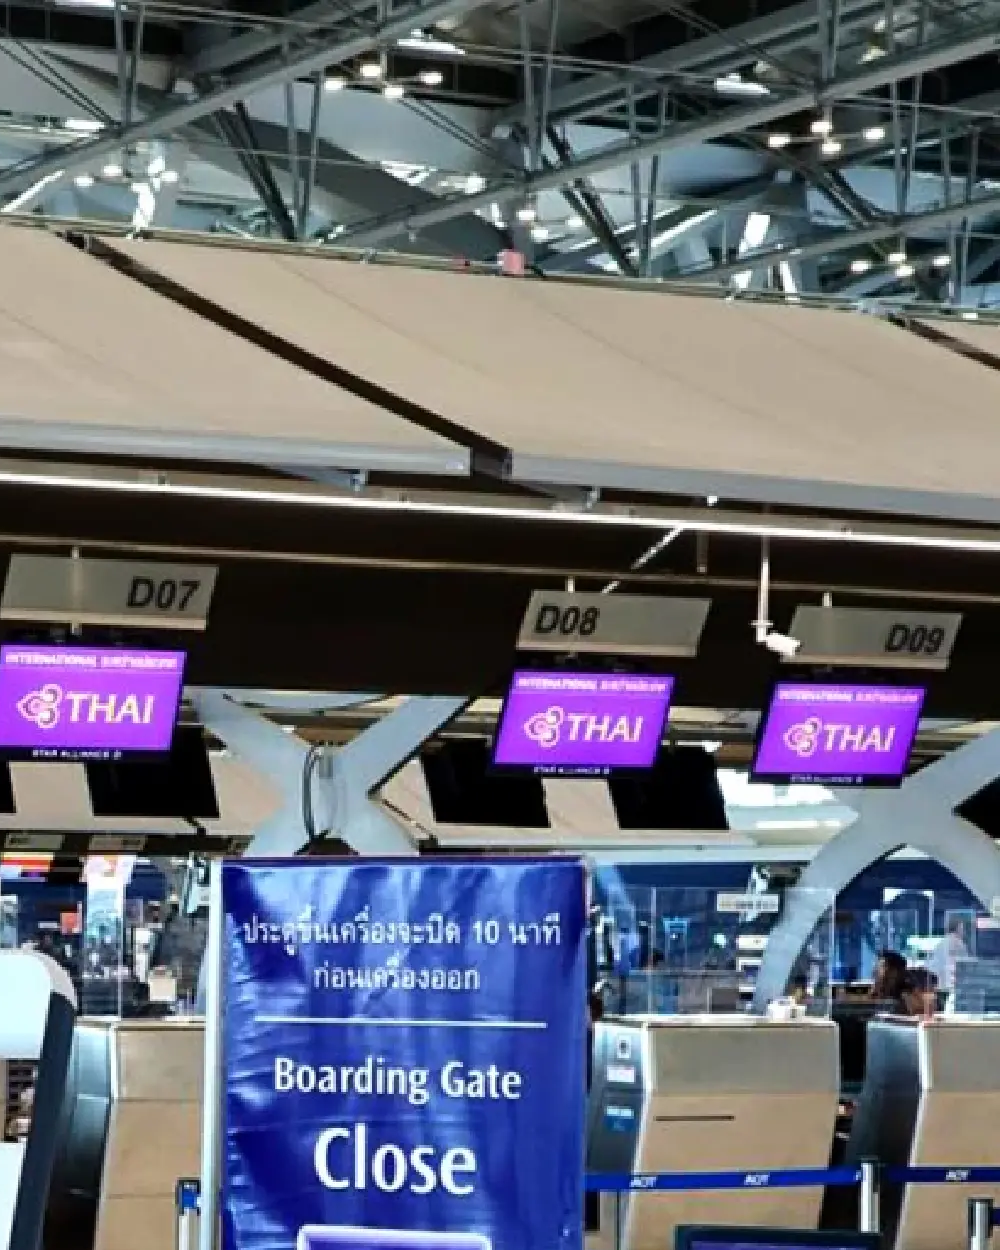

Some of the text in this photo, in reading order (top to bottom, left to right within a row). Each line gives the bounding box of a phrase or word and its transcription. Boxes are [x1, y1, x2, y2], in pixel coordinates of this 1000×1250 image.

[126, 576, 199, 611] D07
[534, 604, 599, 636] D08
[884, 624, 945, 654] D09
[5, 652, 97, 669] INTERNATIONAL
[65, 691, 155, 725] THAI
[566, 712, 645, 743] THAI
[823, 724, 896, 753] THAI
[243, 904, 561, 956] ประตูขึ้นเครื่องจะปิด 10 นาที
[313, 952, 480, 990] ก่อนเครื่องออก
[274, 1055, 522, 1105] Boarding Gate
[313, 1122, 477, 1195] Close
[630, 1175, 658, 1189] AOT
[744, 1173, 770, 1186] AOT
[945, 1168, 970, 1181] AOT
